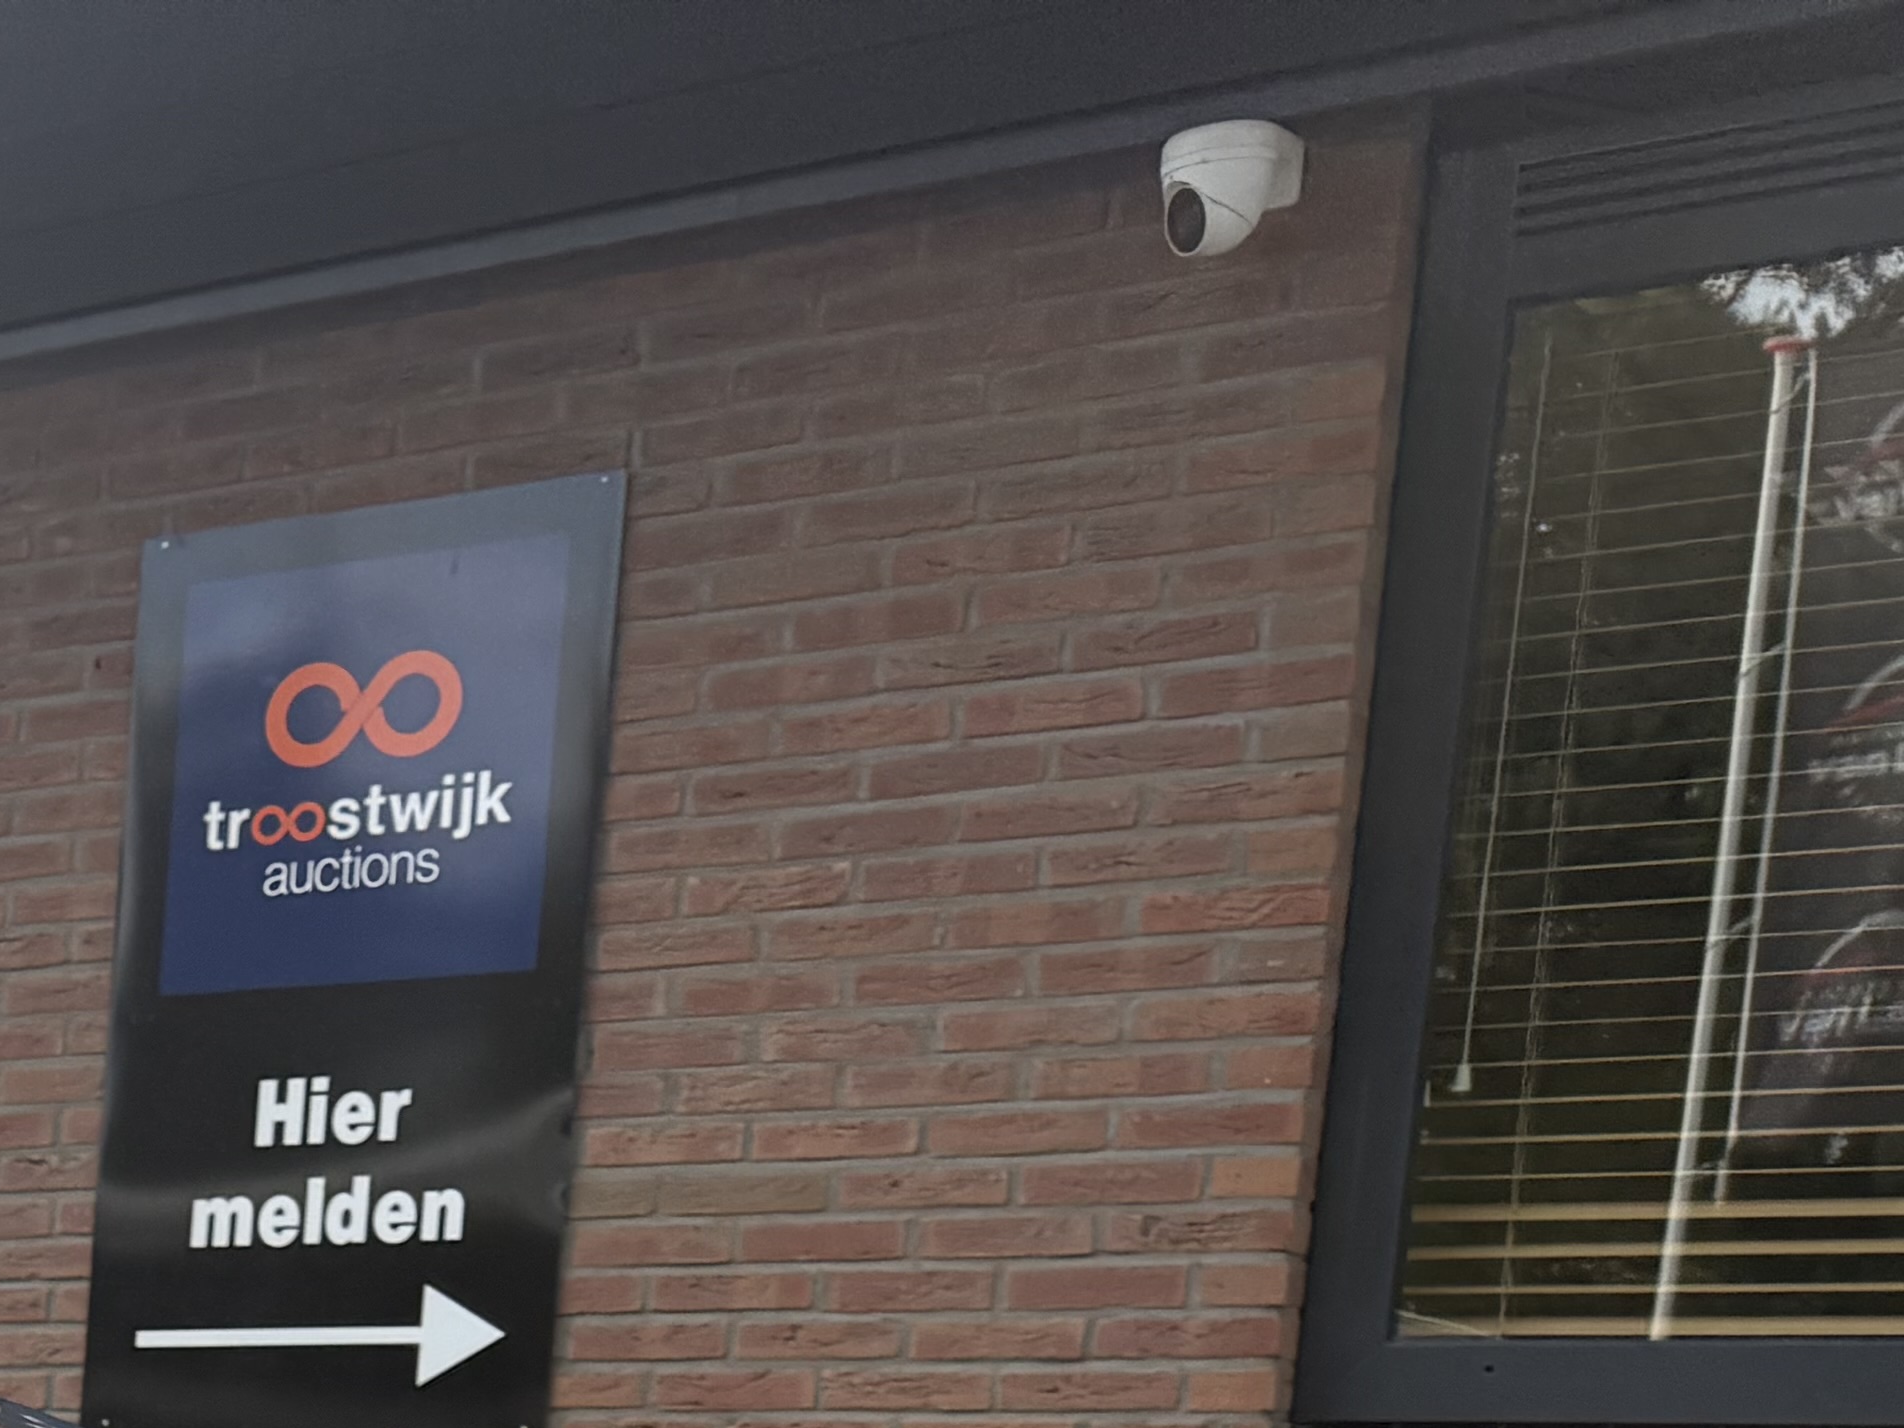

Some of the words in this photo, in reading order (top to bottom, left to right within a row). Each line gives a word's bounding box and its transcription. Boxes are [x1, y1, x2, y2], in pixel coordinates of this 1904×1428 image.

[203, 769, 512, 850] troostwijk
[263, 845, 440, 898] auctions
[254, 1076, 413, 1147] Hier
[189, 1174, 465, 1248] melden
